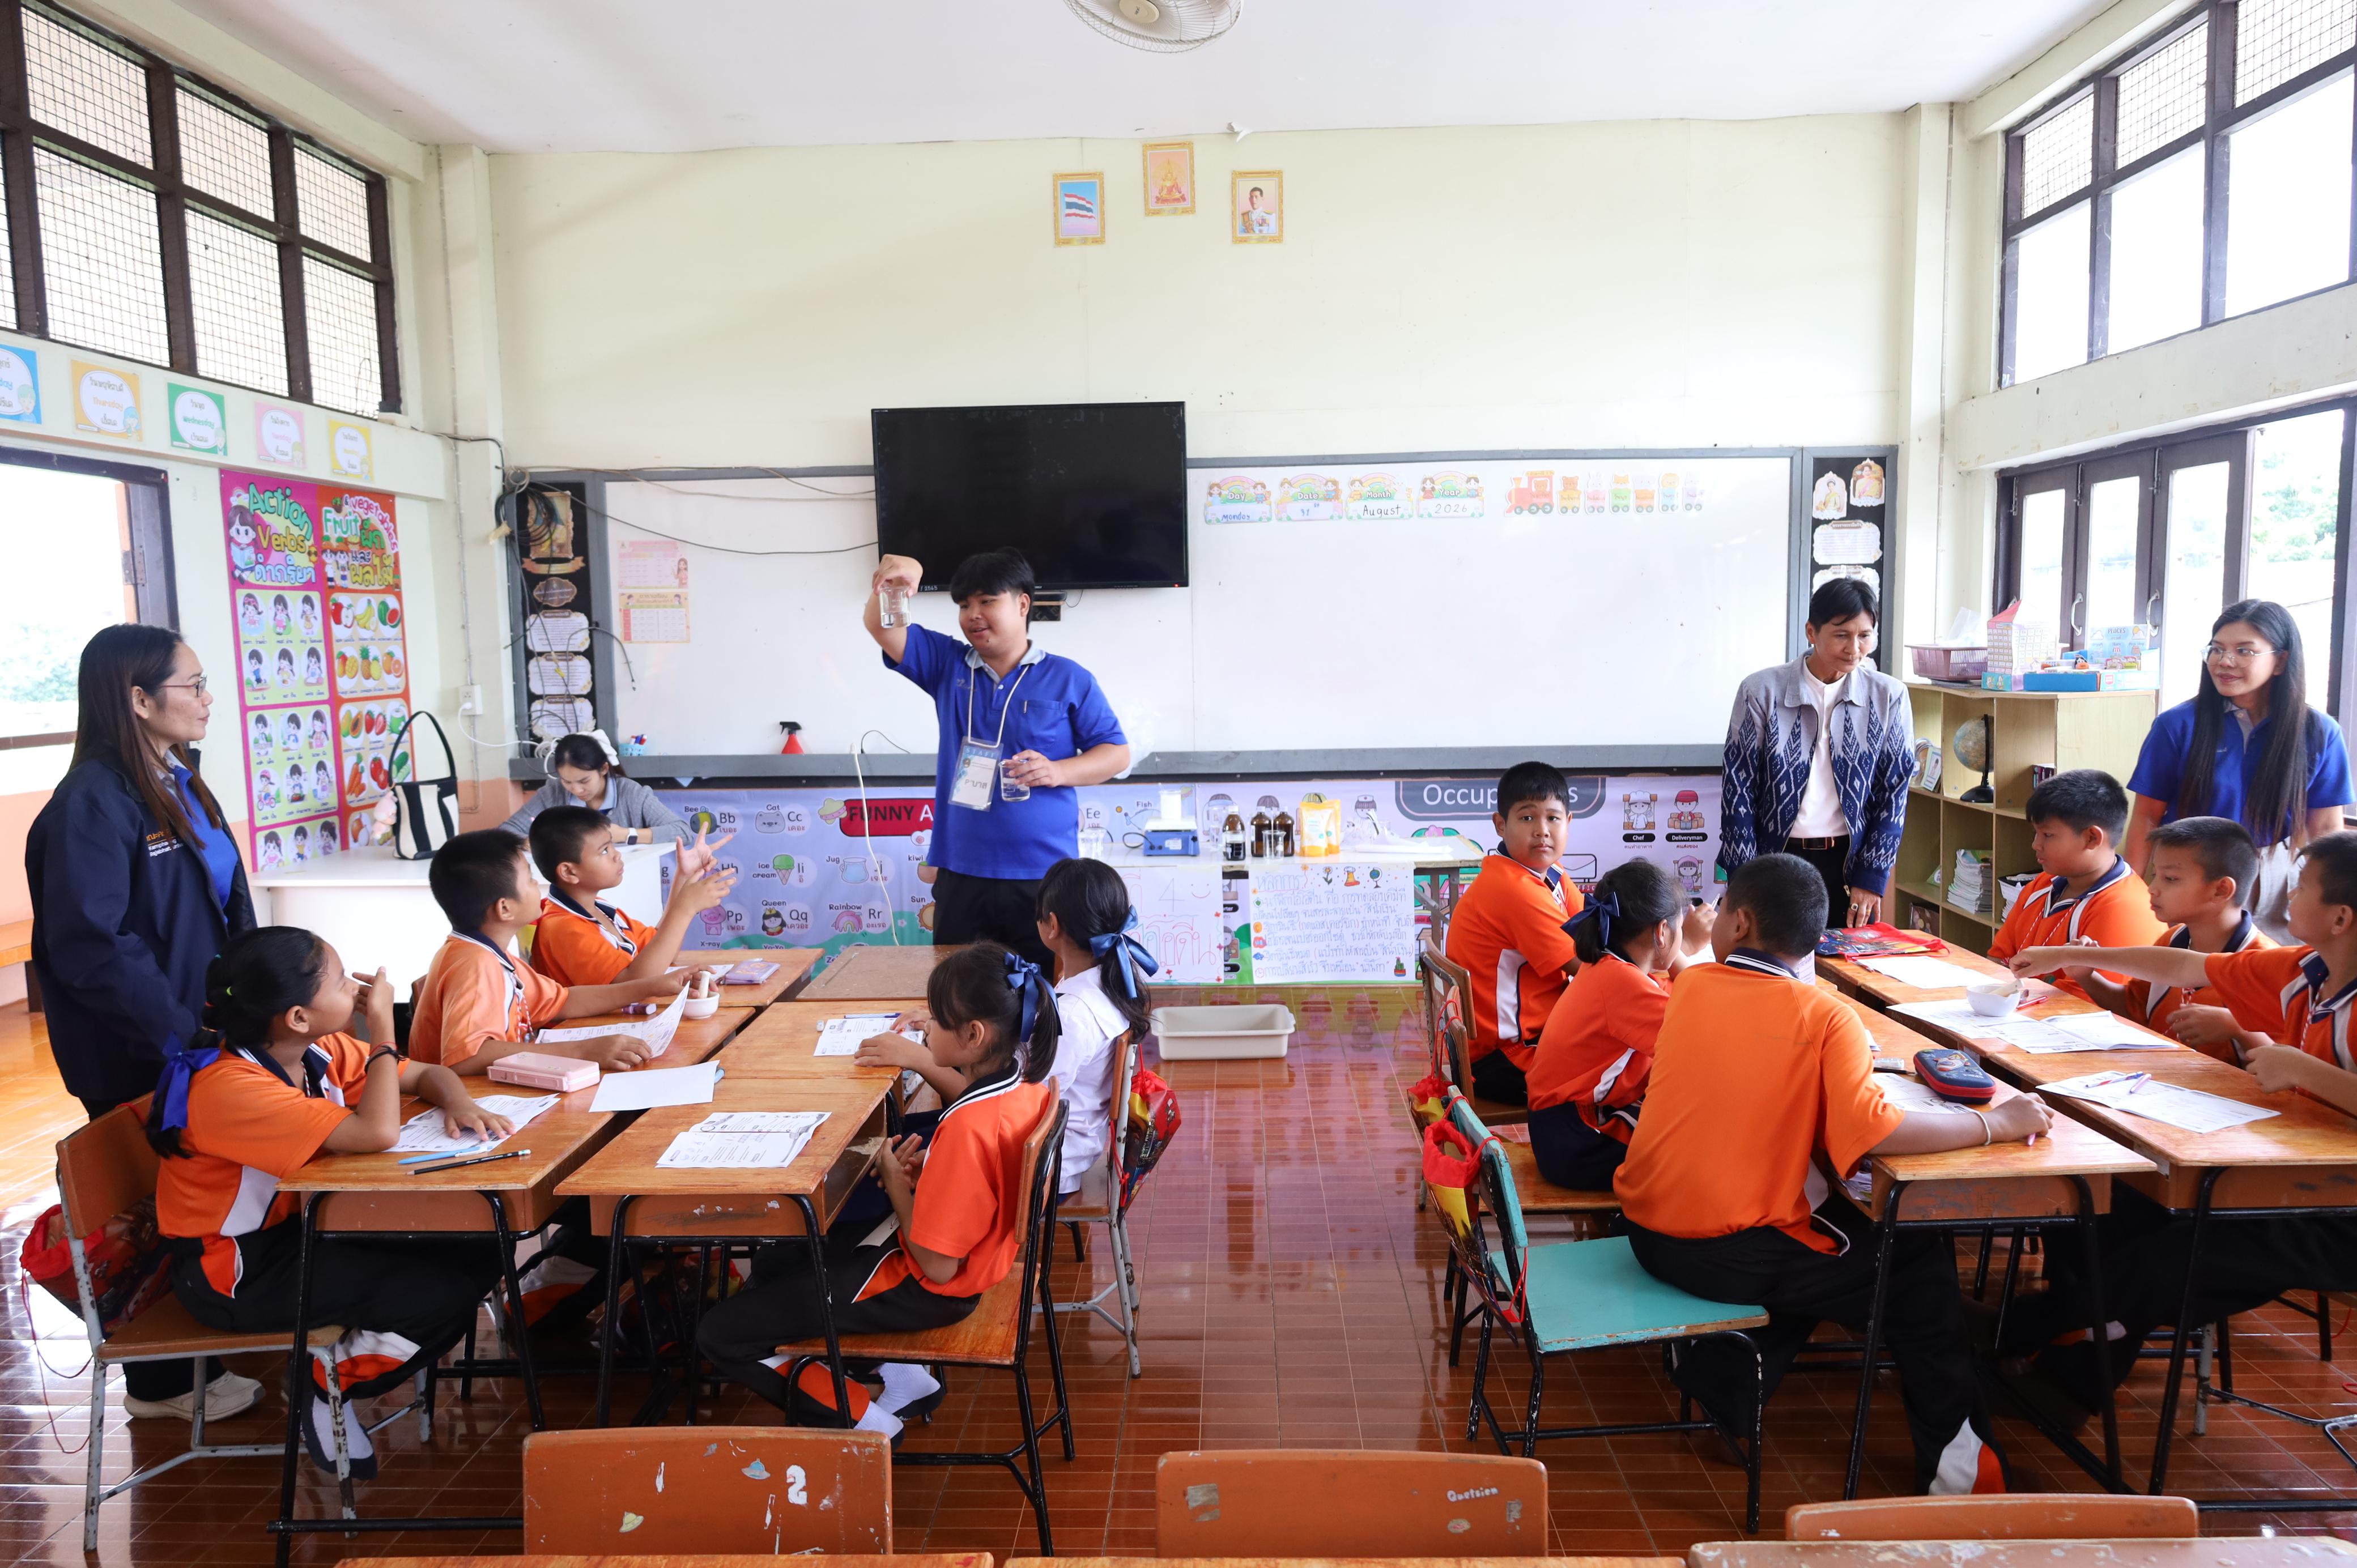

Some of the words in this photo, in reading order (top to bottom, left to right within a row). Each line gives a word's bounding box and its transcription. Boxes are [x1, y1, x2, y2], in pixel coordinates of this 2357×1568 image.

[1228, 492, 1246, 502] Day
[1366, 489, 1392, 499] Month
[248, 482, 313, 541] Action
[1363, 504, 1401, 518] August
[322, 508, 361, 536] Fruit
[344, 494, 349, 506] &
[351, 496, 398, 553] vegetables
[257, 525, 307, 553] Verbs
[361, 518, 385, 549] ผัก
[254, 553, 316, 585] คำกริยา
[350, 553, 394, 585] ผลไม้
[720, 813, 735, 823] Bb
[788, 811, 802, 821] Cc
[850, 806, 914, 821] FUNNY
[1086, 808, 1100, 819] Ee
[1158, 877, 1185, 913] 4
[727, 910, 743, 923] Pp
[789, 909, 808, 923] Qq
[869, 909, 883, 919] Rr
[786, 1464, 807, 1505] 2
